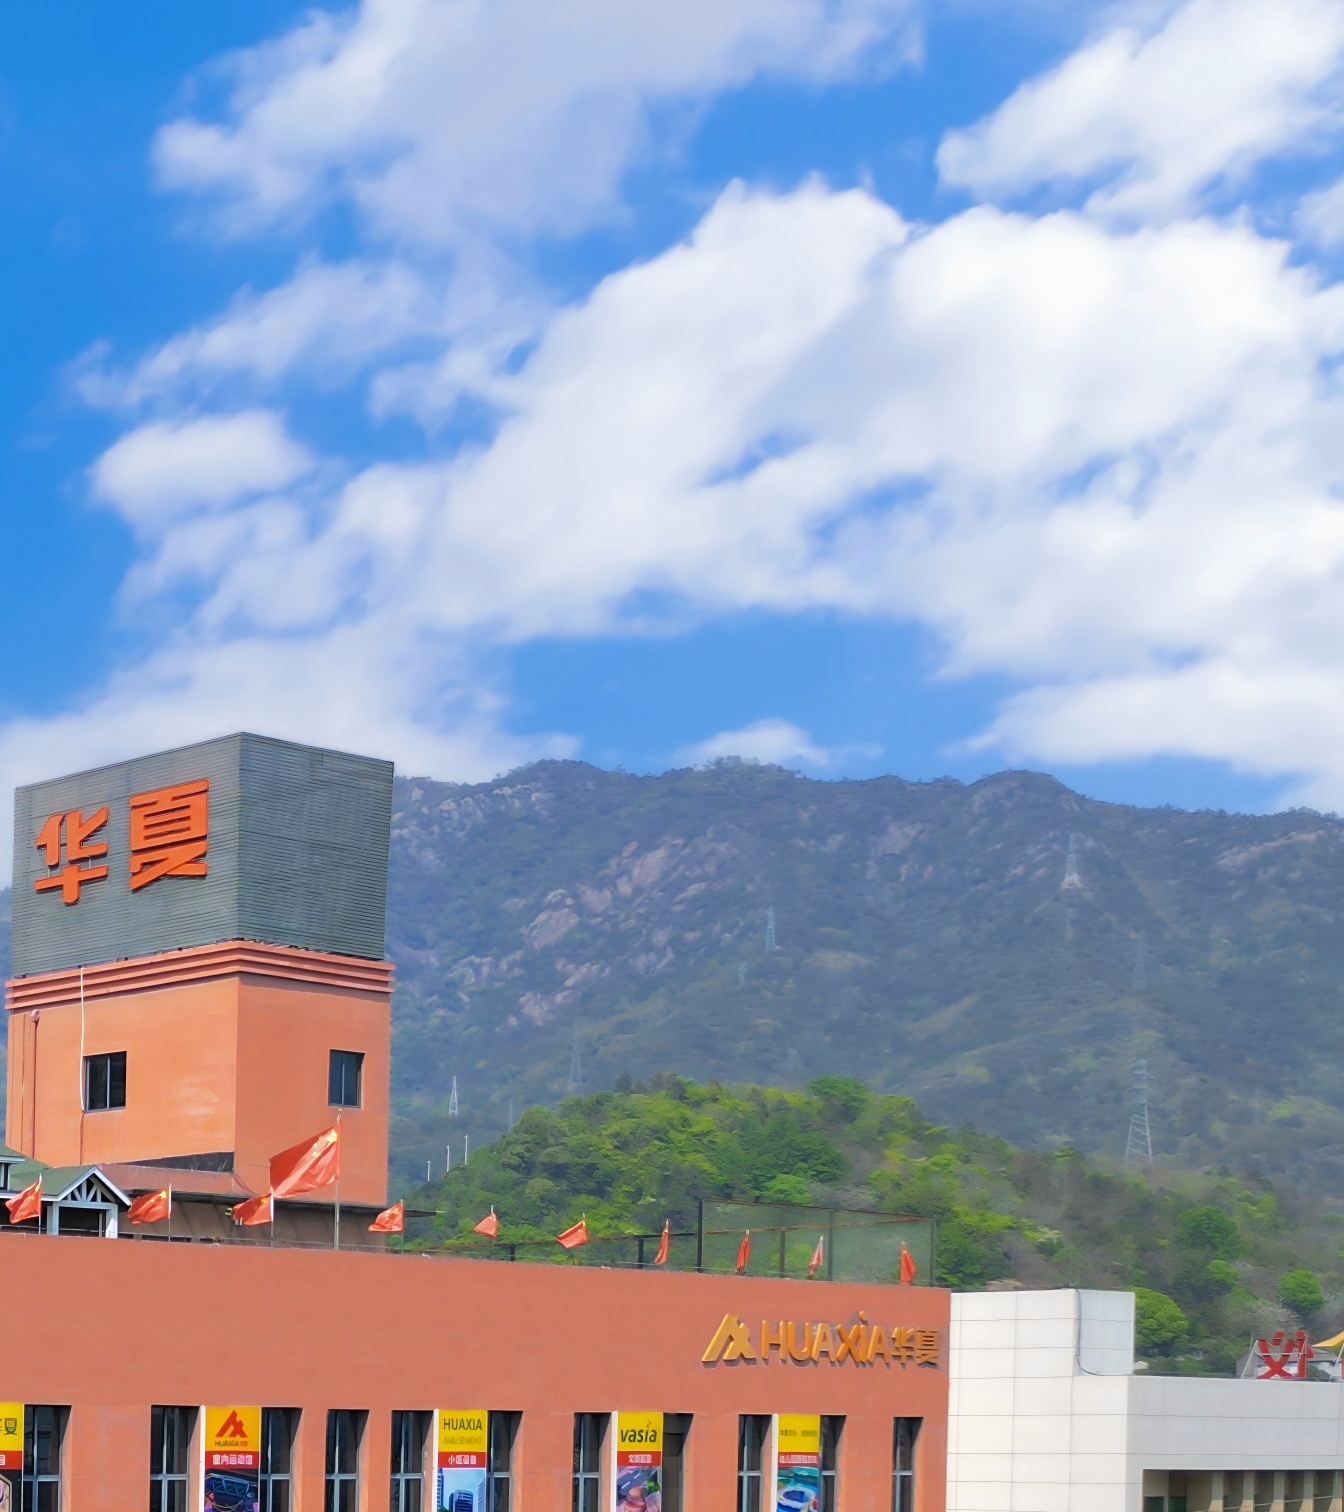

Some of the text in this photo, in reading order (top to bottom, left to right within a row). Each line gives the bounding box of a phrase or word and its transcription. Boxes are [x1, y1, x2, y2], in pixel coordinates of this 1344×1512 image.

[34, 779, 210, 905] 华夏
[443, 1417, 483, 1431] HUAXIA
[620, 1420, 658, 1443] vasia
